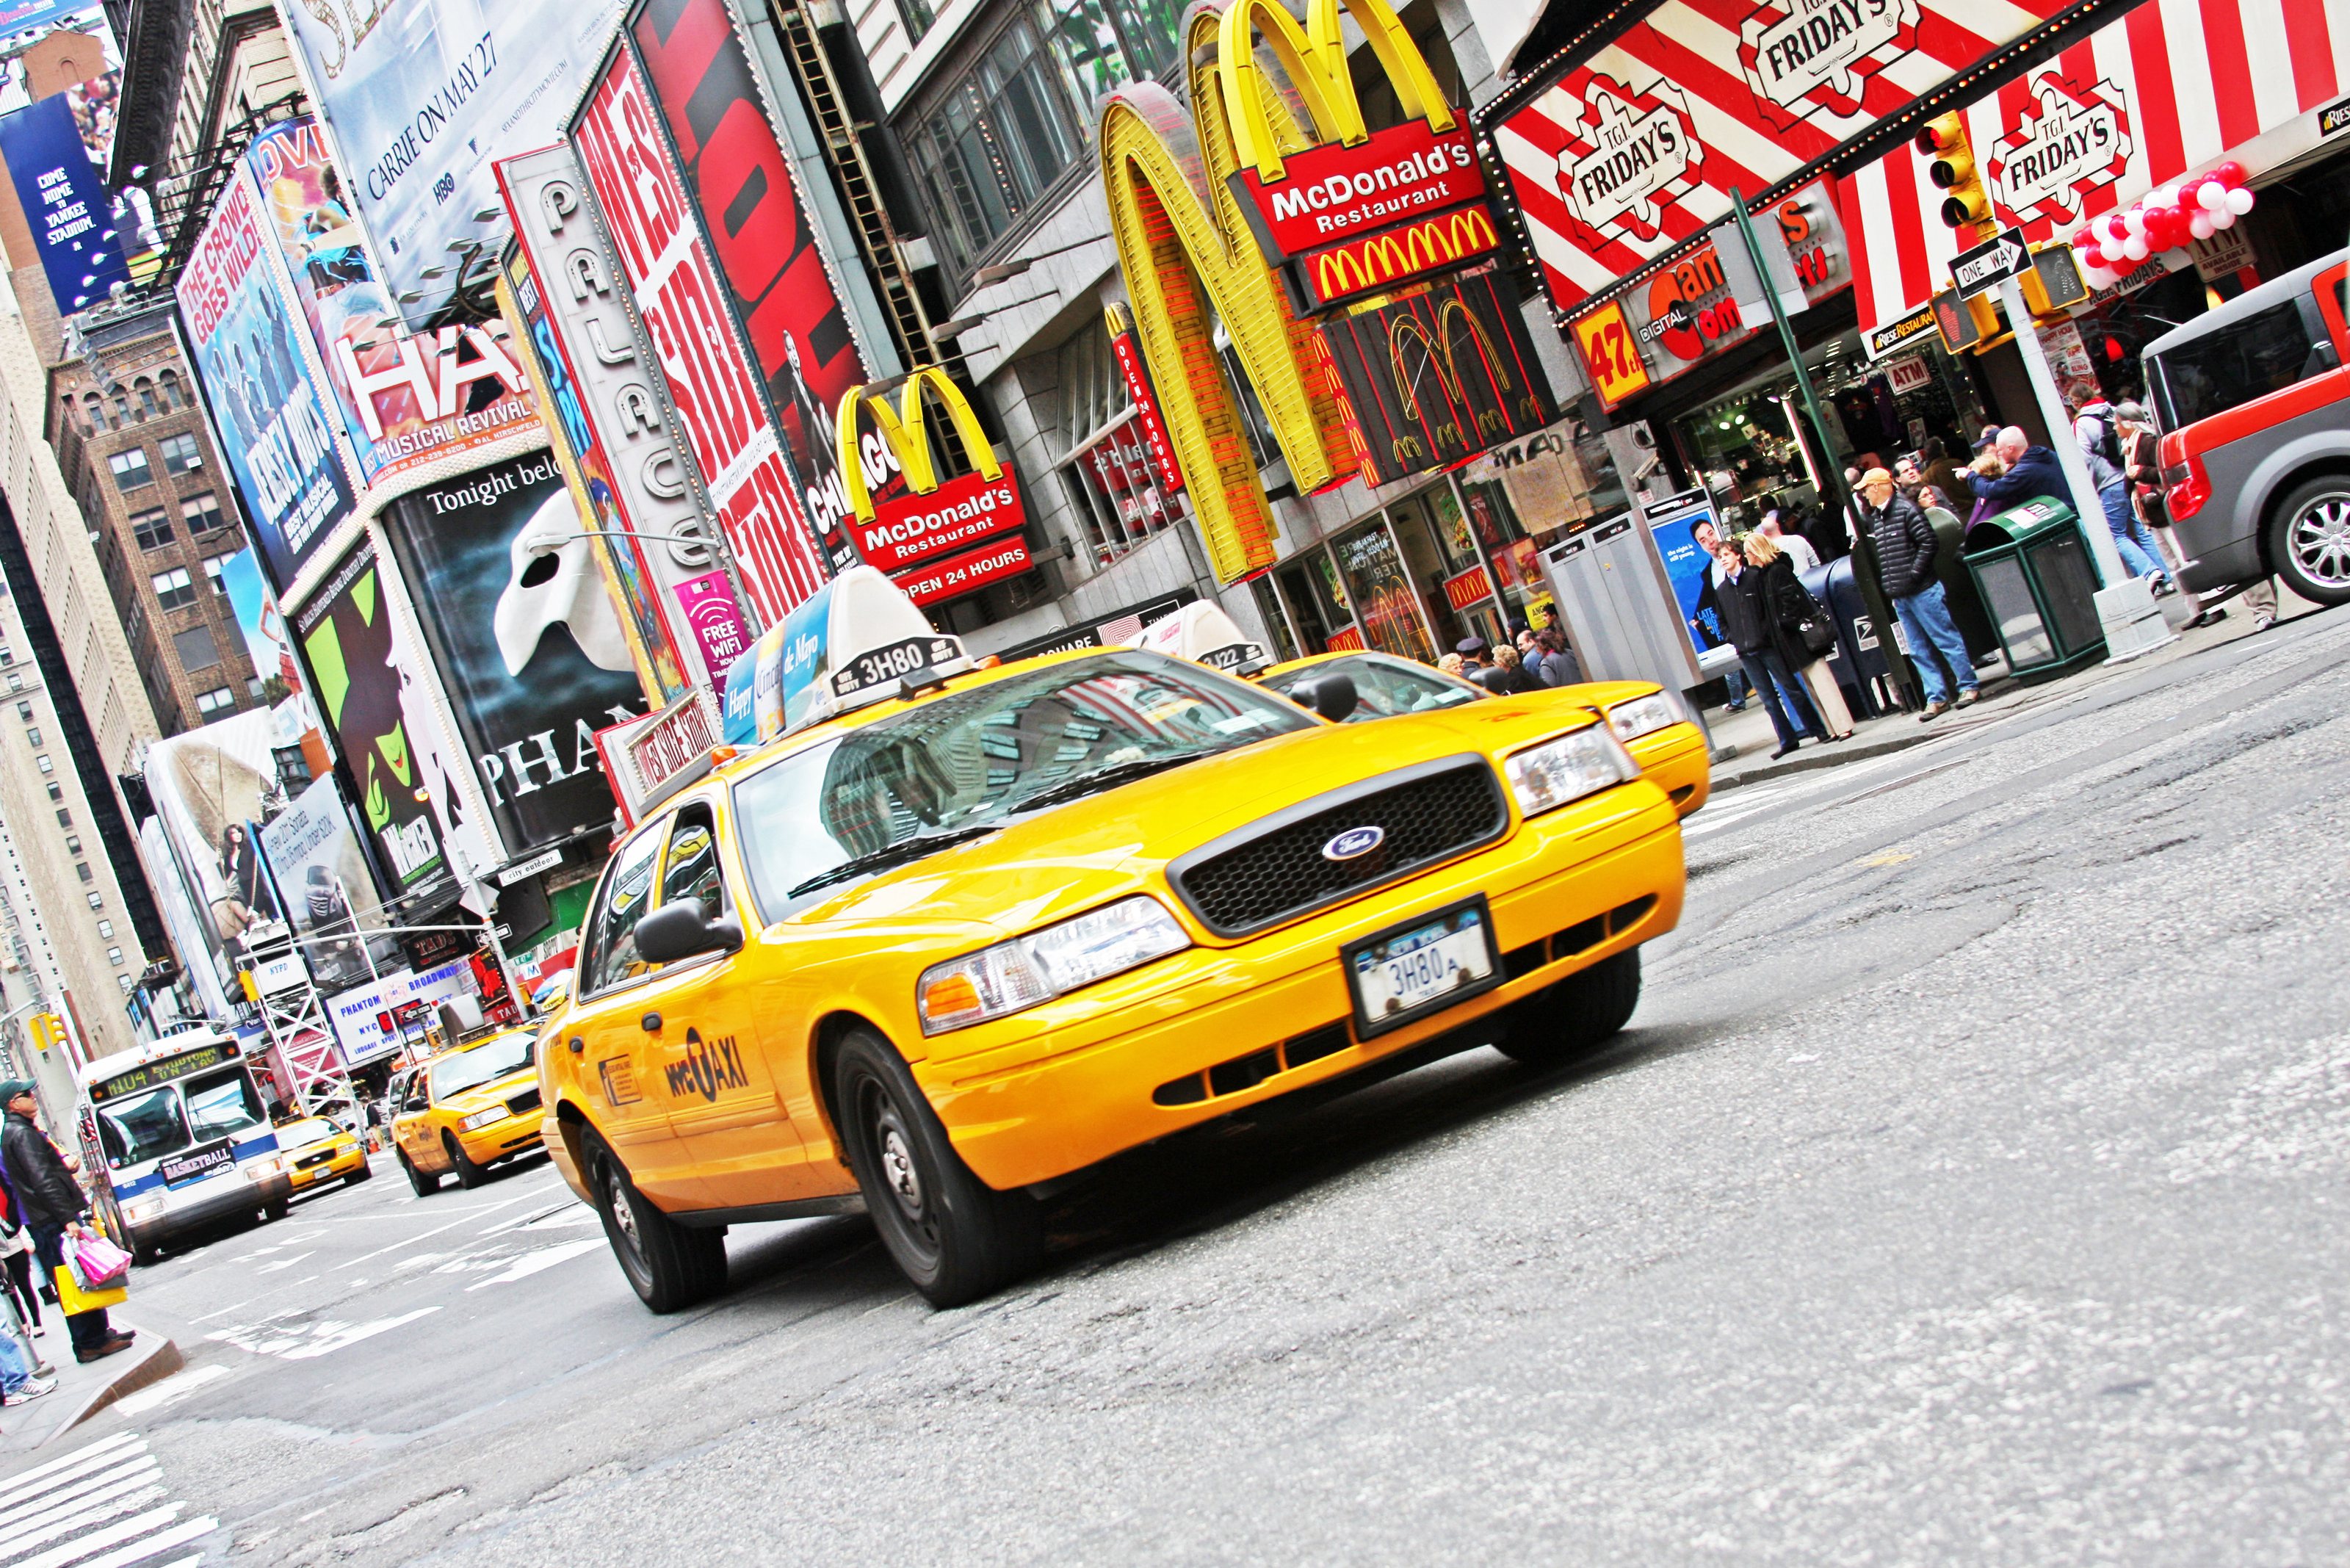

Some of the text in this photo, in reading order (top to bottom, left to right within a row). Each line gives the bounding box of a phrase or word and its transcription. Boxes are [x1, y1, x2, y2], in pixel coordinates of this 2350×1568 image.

[1765, 0, 1887, 82] FRIDAYS
[367, 125, 421, 200] CARRIE
[416, 95, 446, 143] ON
[441, 54, 480, 118] MAY
[474, 31, 497, 77] 27
[2041, 118, 2068, 143] T.G.I.
[1603, 120, 1631, 151] T.G.I.
[1578, 117, 1678, 208] FRIDAY'S
[2009, 117, 2111, 194] FRIDAY'S
[37, 167, 68, 189] COME
[42, 181, 73, 205] HOME
[433, 172, 455, 206] HBO
[1271, 142, 1472, 223] McDonald's
[45, 200, 88, 228] YANKEE
[1316, 181, 1450, 234] Restaurant
[204, 181, 250, 275] CROWD
[1962, 245, 2017, 283] ONE WAY
[2202, 245, 2247, 271] AVAILABLE
[2213, 259, 2242, 275] INSIDE
[193, 275, 228, 346] GOES
[1640, 311, 1688, 344] DIGITAL
[1878, 328, 1899, 347] RIESE
[334, 323, 530, 442] HA
[540, 179, 712, 570] PALACE
[1893, 360, 1927, 389] ATM
[375, 423, 455, 465] MUSICAL
[456, 399, 532, 437] REVIVAL
[494, 419, 540, 440] HIRSCHFELD
[1118, 344, 1176, 485] OPEN 24 HOURS
[245, 413, 304, 526] JERSEY
[282, 375, 331, 478] BOYS
[426, 470, 518, 516] Tonight
[806, 426, 902, 535] CHIAGO
[283, 507, 305, 541] BEST
[300, 473, 333, 519] MUSICAL
[864, 488, 1014, 552] McDonald's
[894, 516, 995, 560] Restaurant
[945, 568, 968, 585] 24
[969, 548, 1026, 577] HOURS
[701, 619, 739, 644] FREE
[1696, 607, 1714, 621] LATE
[1704, 615, 1718, 629] NIG
[709, 636, 744, 660] WIFI
[784, 632, 819, 675] de Mayo
[930, 638, 949, 651] OFF
[930, 647, 955, 664] DUTY
[837, 669, 854, 684] OFF
[859, 643, 924, 685] 3H80
[728, 683, 753, 721] Happy
[836, 679, 860, 694] DUTY
[634, 695, 714, 789] WEST SIDE STORY
[1338, 829, 1372, 852] Ford
[508, 855, 554, 880] city outdoor
[270, 963, 289, 976] NYPD
[1388, 947, 1445, 997] 3H80
[340, 994, 381, 1018] PHANTOM
[408, 964, 458, 991] BROADWAY
[358, 1022, 379, 1035] NYC
[165, 1048, 218, 1069] MIDTOWN
[664, 1060, 696, 1098] NYC
[688, 1028, 749, 1101] TAXI
[164, 1148, 231, 1180] BASKETBALL
